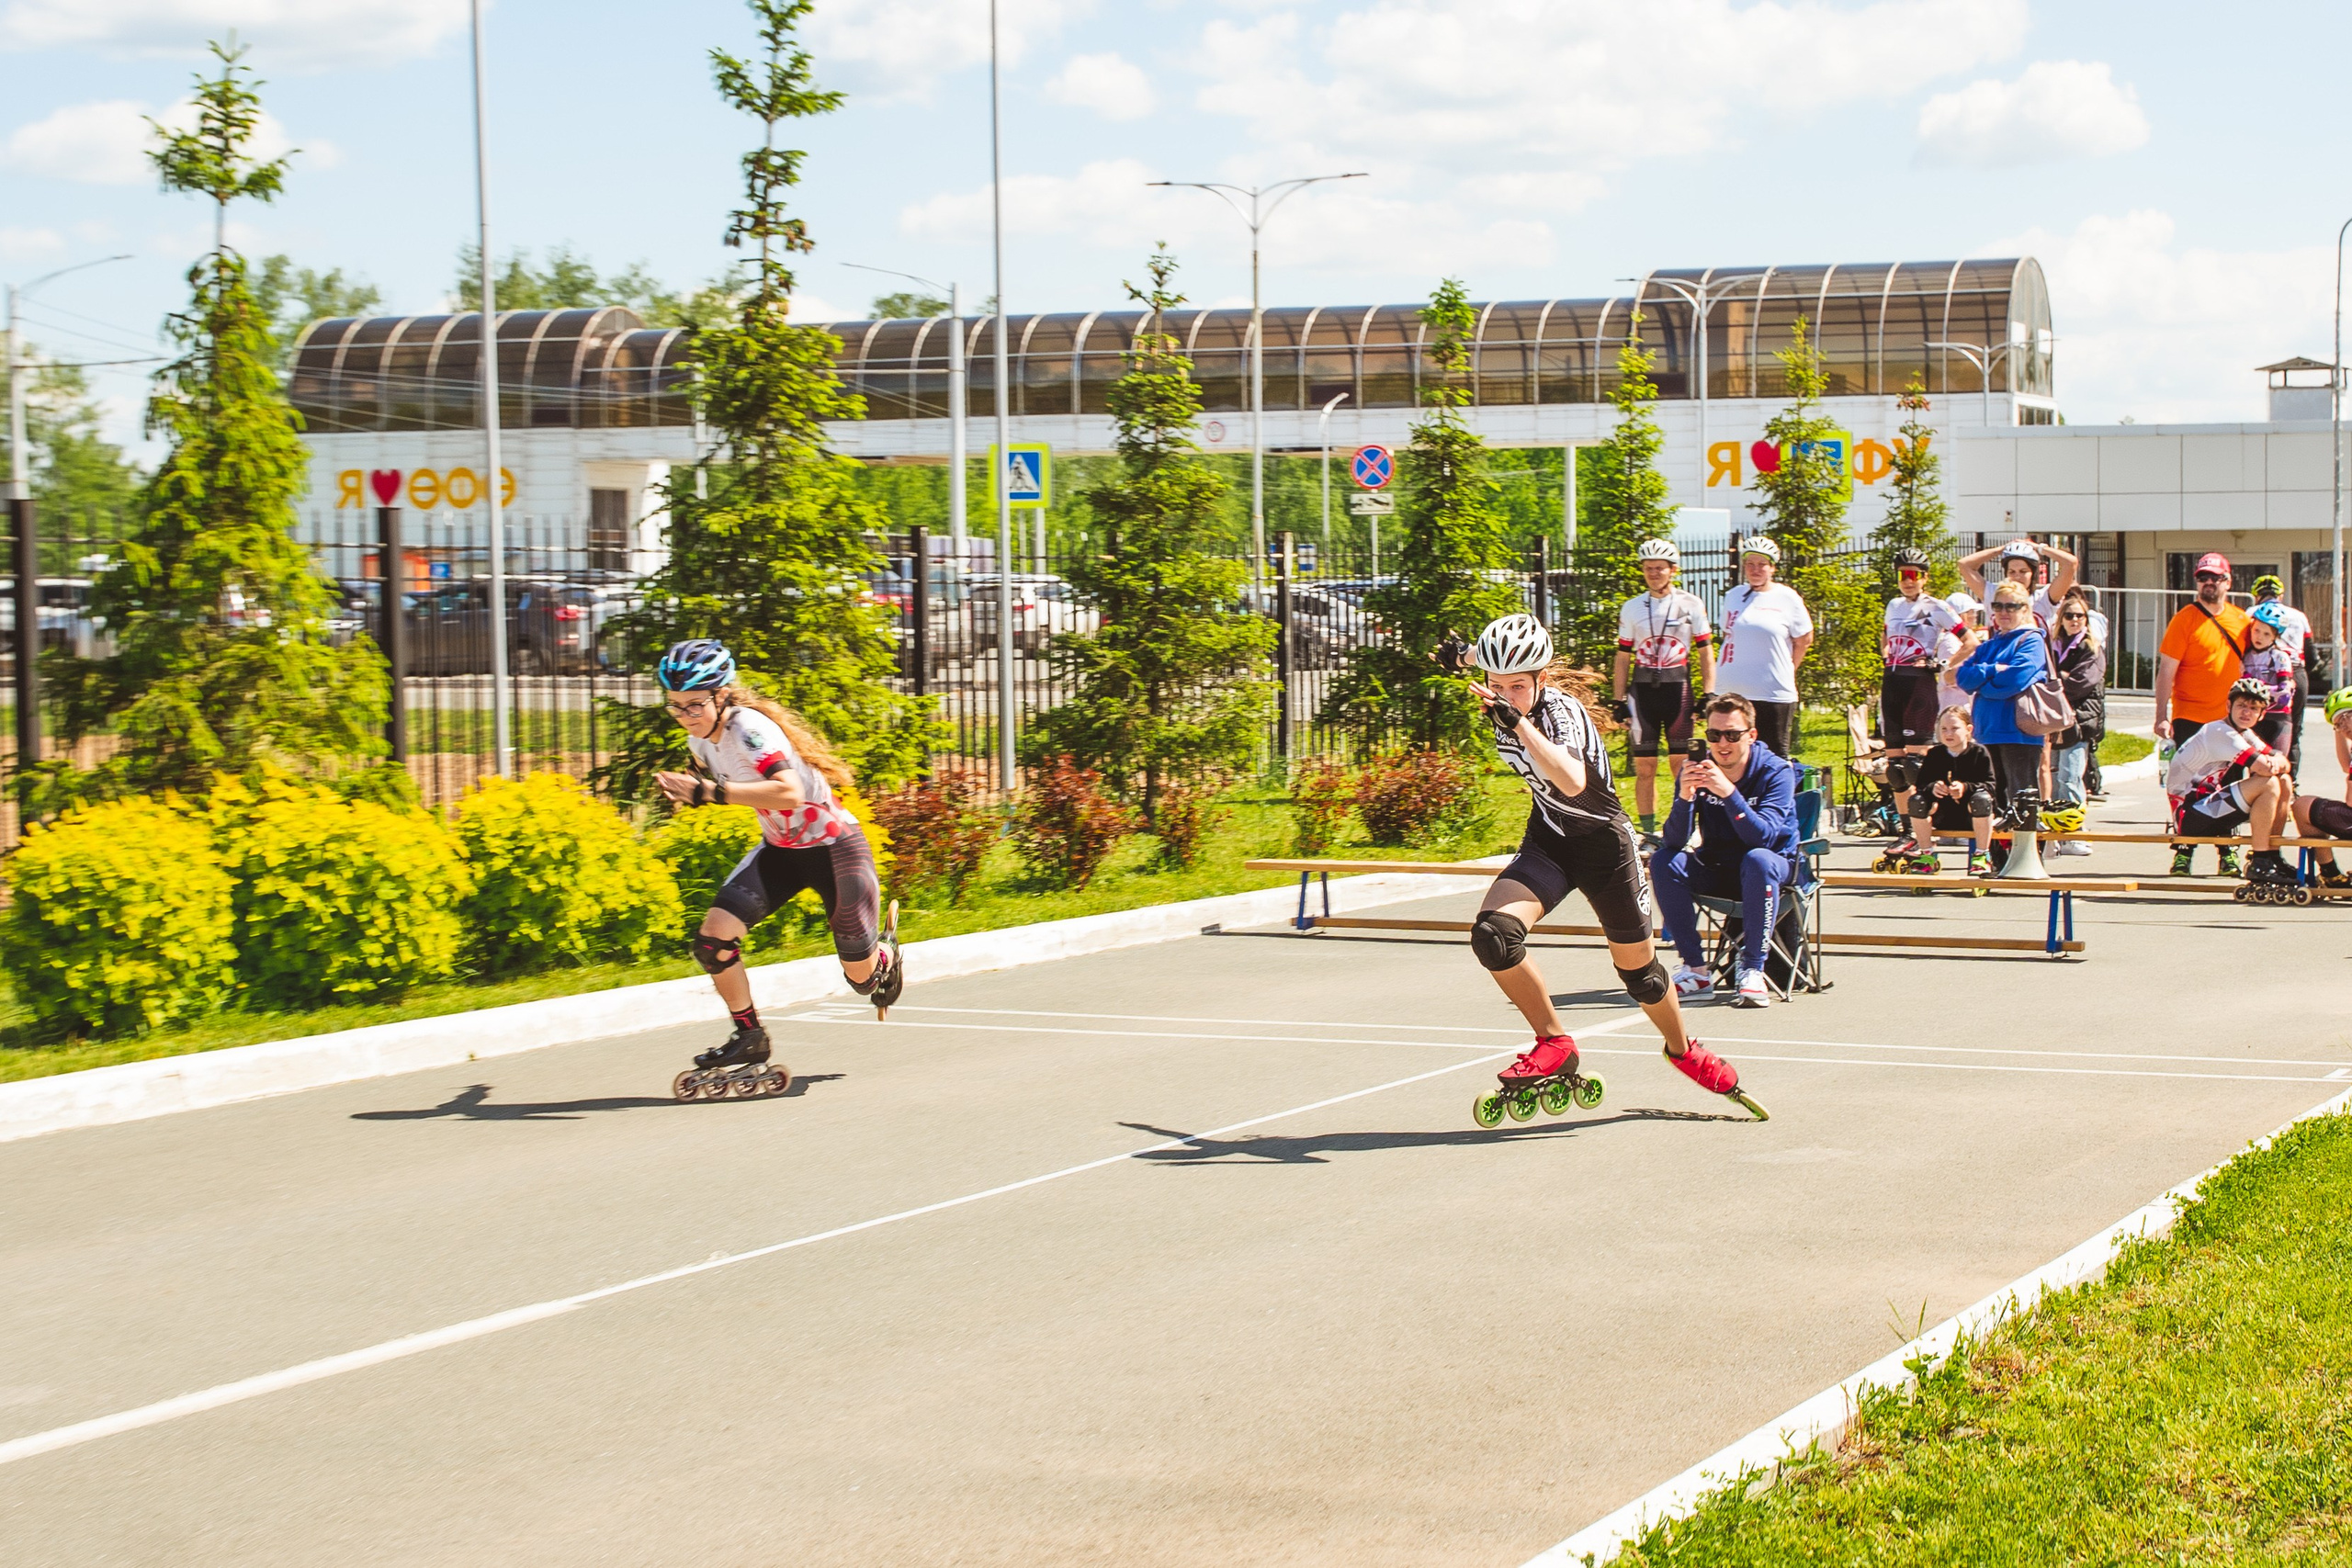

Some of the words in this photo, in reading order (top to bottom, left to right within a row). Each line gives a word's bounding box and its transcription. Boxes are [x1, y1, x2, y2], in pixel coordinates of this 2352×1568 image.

[1707, 441, 1741, 487] Я
[1852, 438, 1932, 485] ФУ
[336, 468, 365, 509] Я
[1764, 897, 1774, 928] TOMMY
[1760, 928, 1771, 953] SPORT
